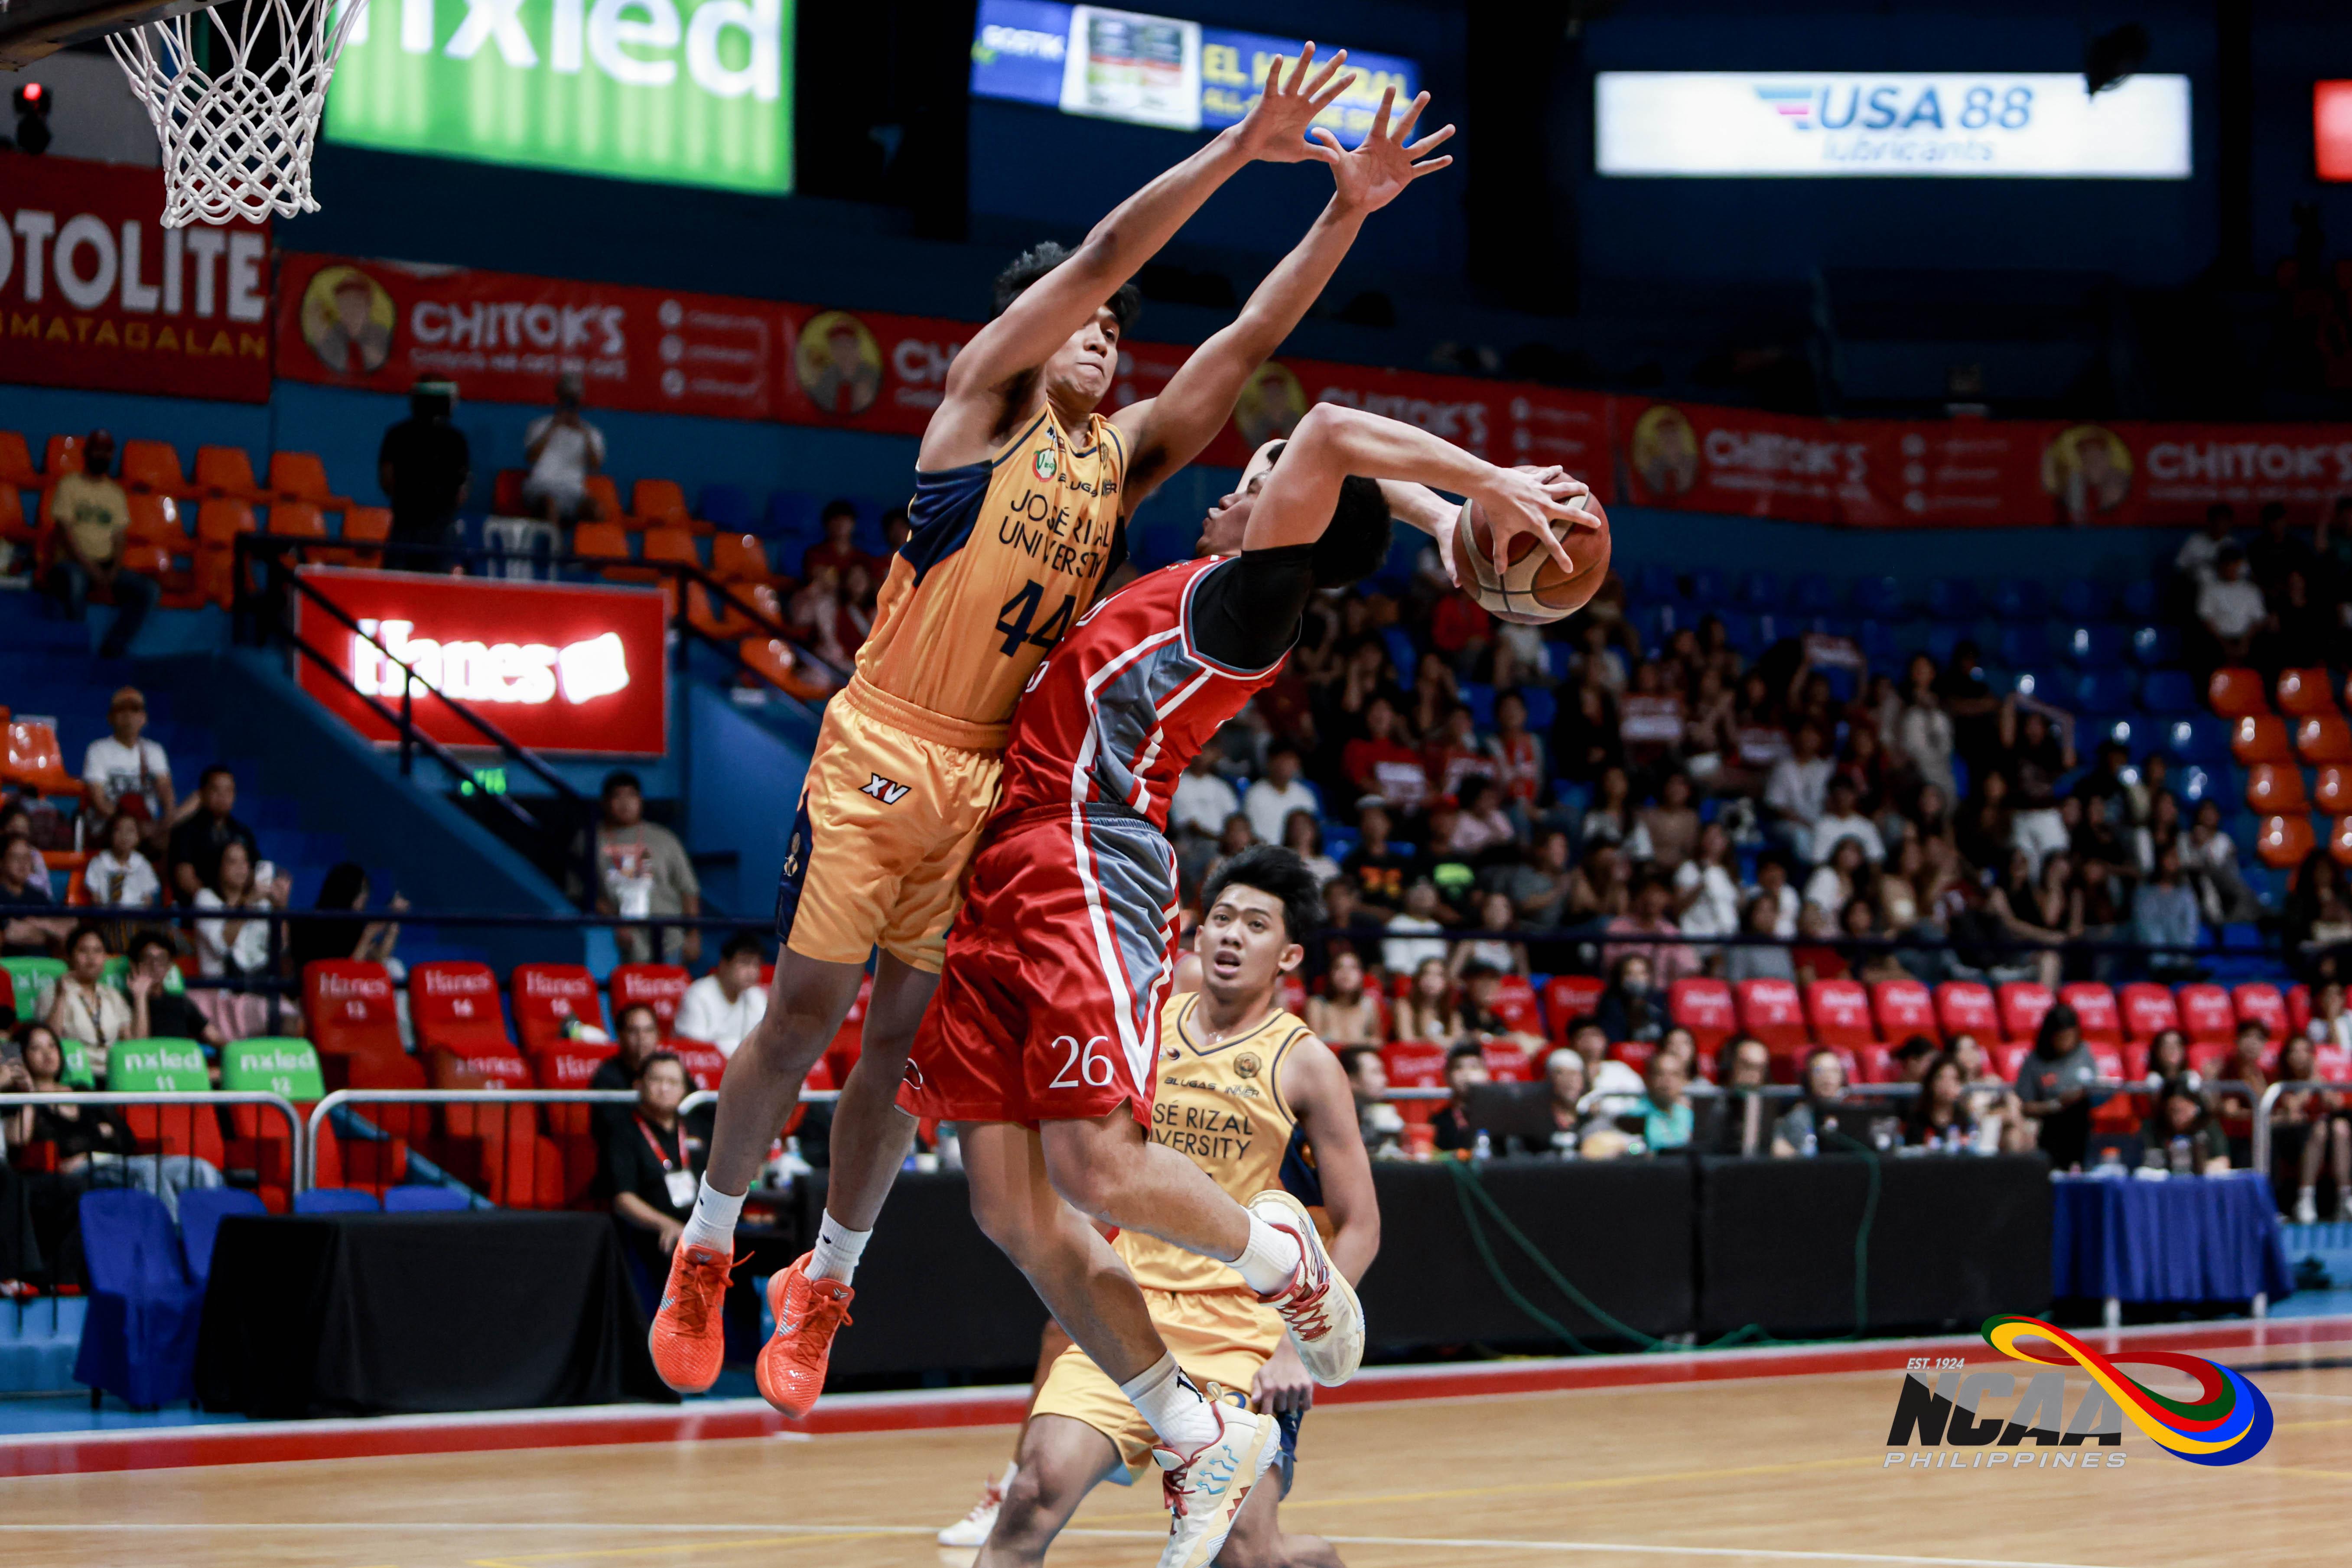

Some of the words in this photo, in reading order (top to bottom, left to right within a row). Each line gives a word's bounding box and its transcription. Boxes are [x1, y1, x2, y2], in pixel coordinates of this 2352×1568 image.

[1820, 86, 1944, 130] USA
[1960, 86, 2033, 130] 88
[0, 208, 266, 323] TOLITE
[0, 312, 266, 360] MATAGALAN
[996, 578, 1076, 657] 44
[125, 1048, 202, 1072] nxled
[241, 1047, 317, 1072] nxled
[1049, 1035, 1114, 1088] 26
[1152, 1100, 1179, 1126] SÉ
[1186, 1107, 1253, 1135] RIZAL
